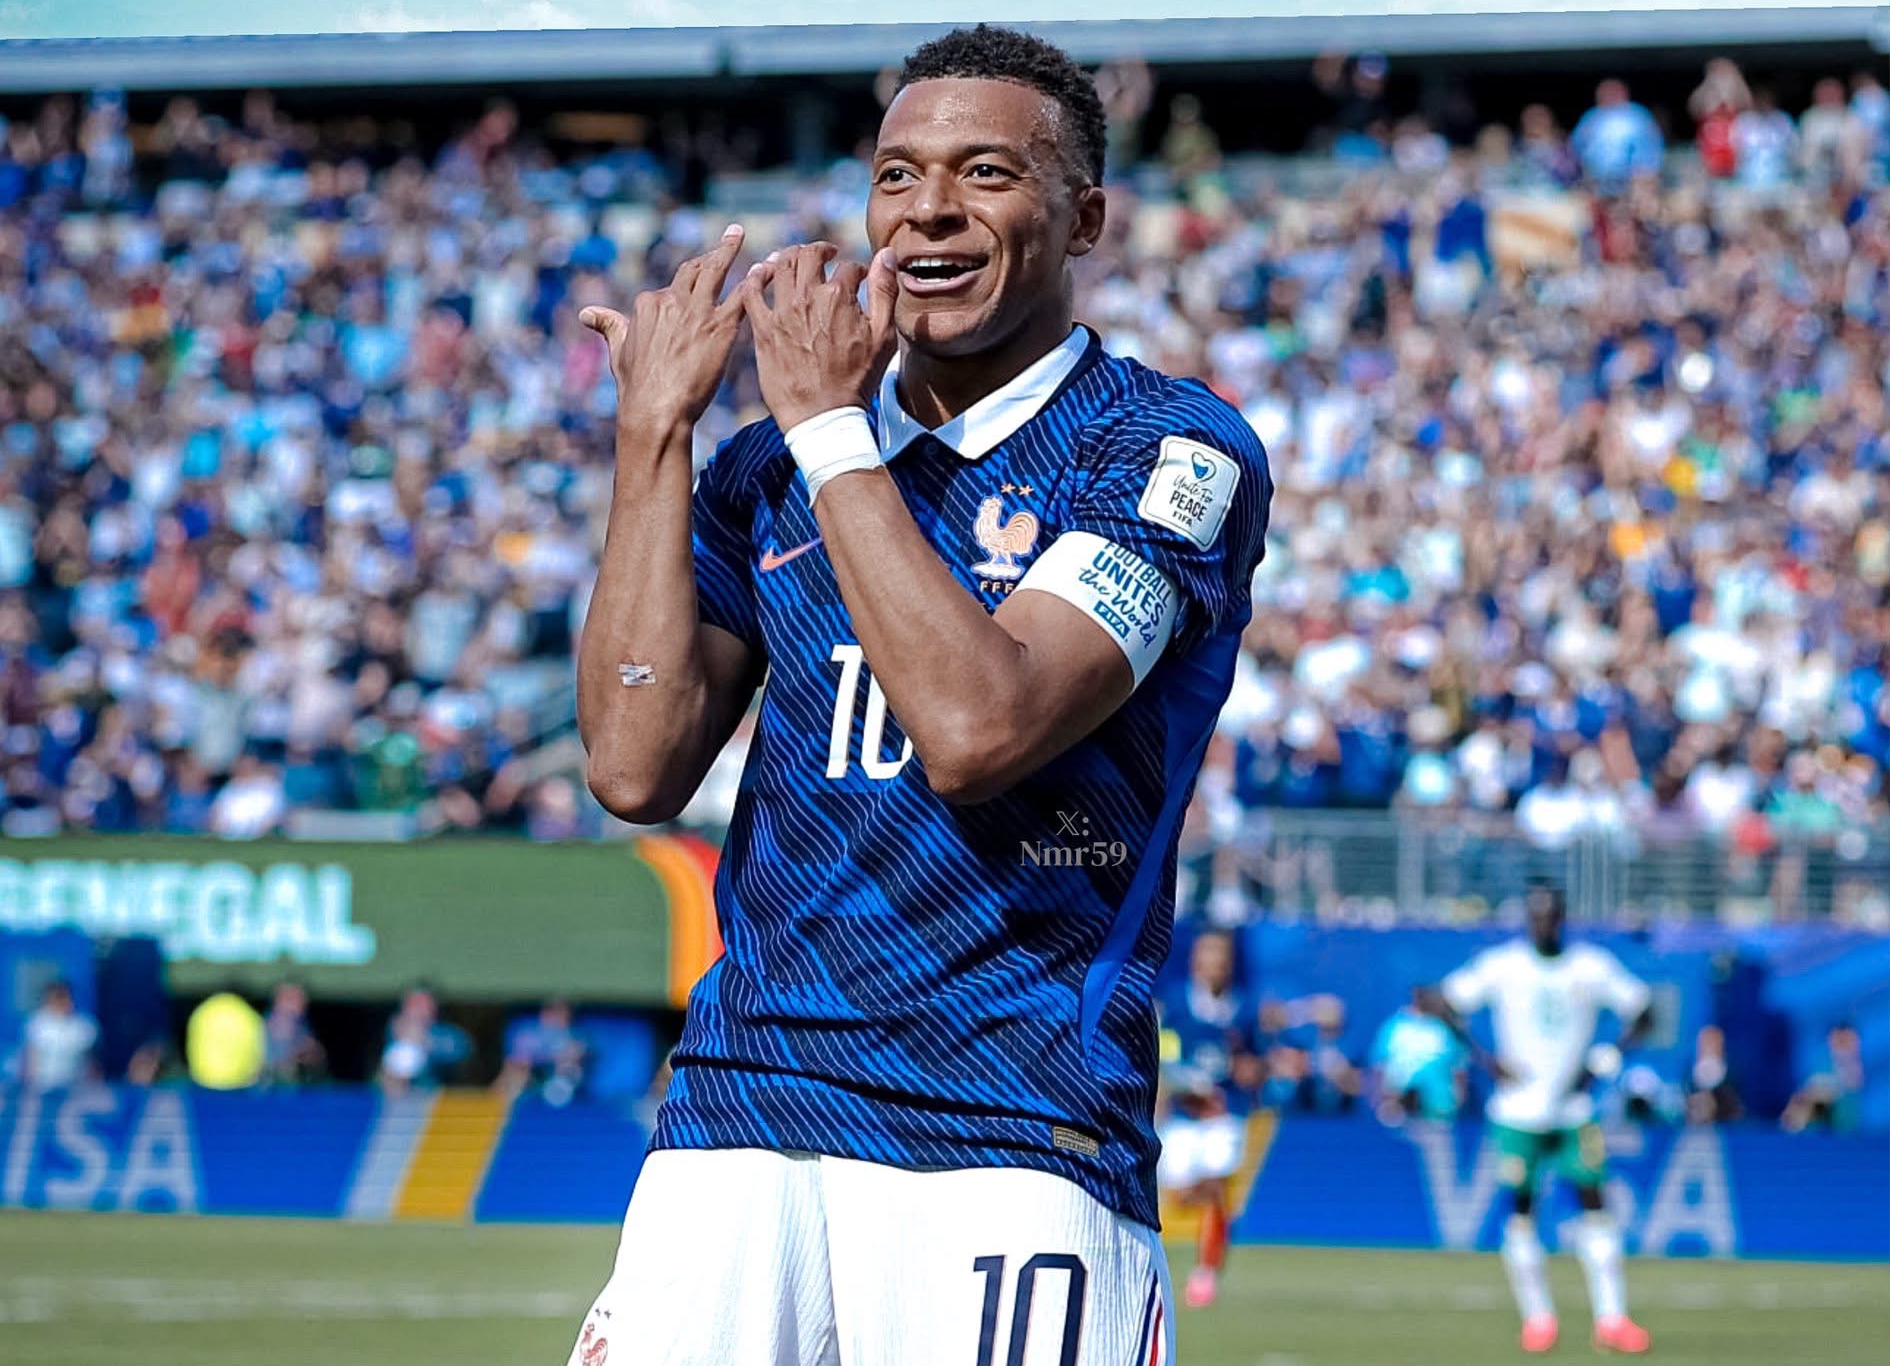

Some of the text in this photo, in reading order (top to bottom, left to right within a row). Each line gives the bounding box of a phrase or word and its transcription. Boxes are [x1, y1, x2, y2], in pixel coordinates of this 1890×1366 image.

[1169, 489, 1208, 523] PEACE
[1172, 510, 1194, 528] FIFA
[1079, 567, 1157, 649] the World
[1093, 550, 1164, 628] UNITES
[0, 1082, 197, 1211] ISA
